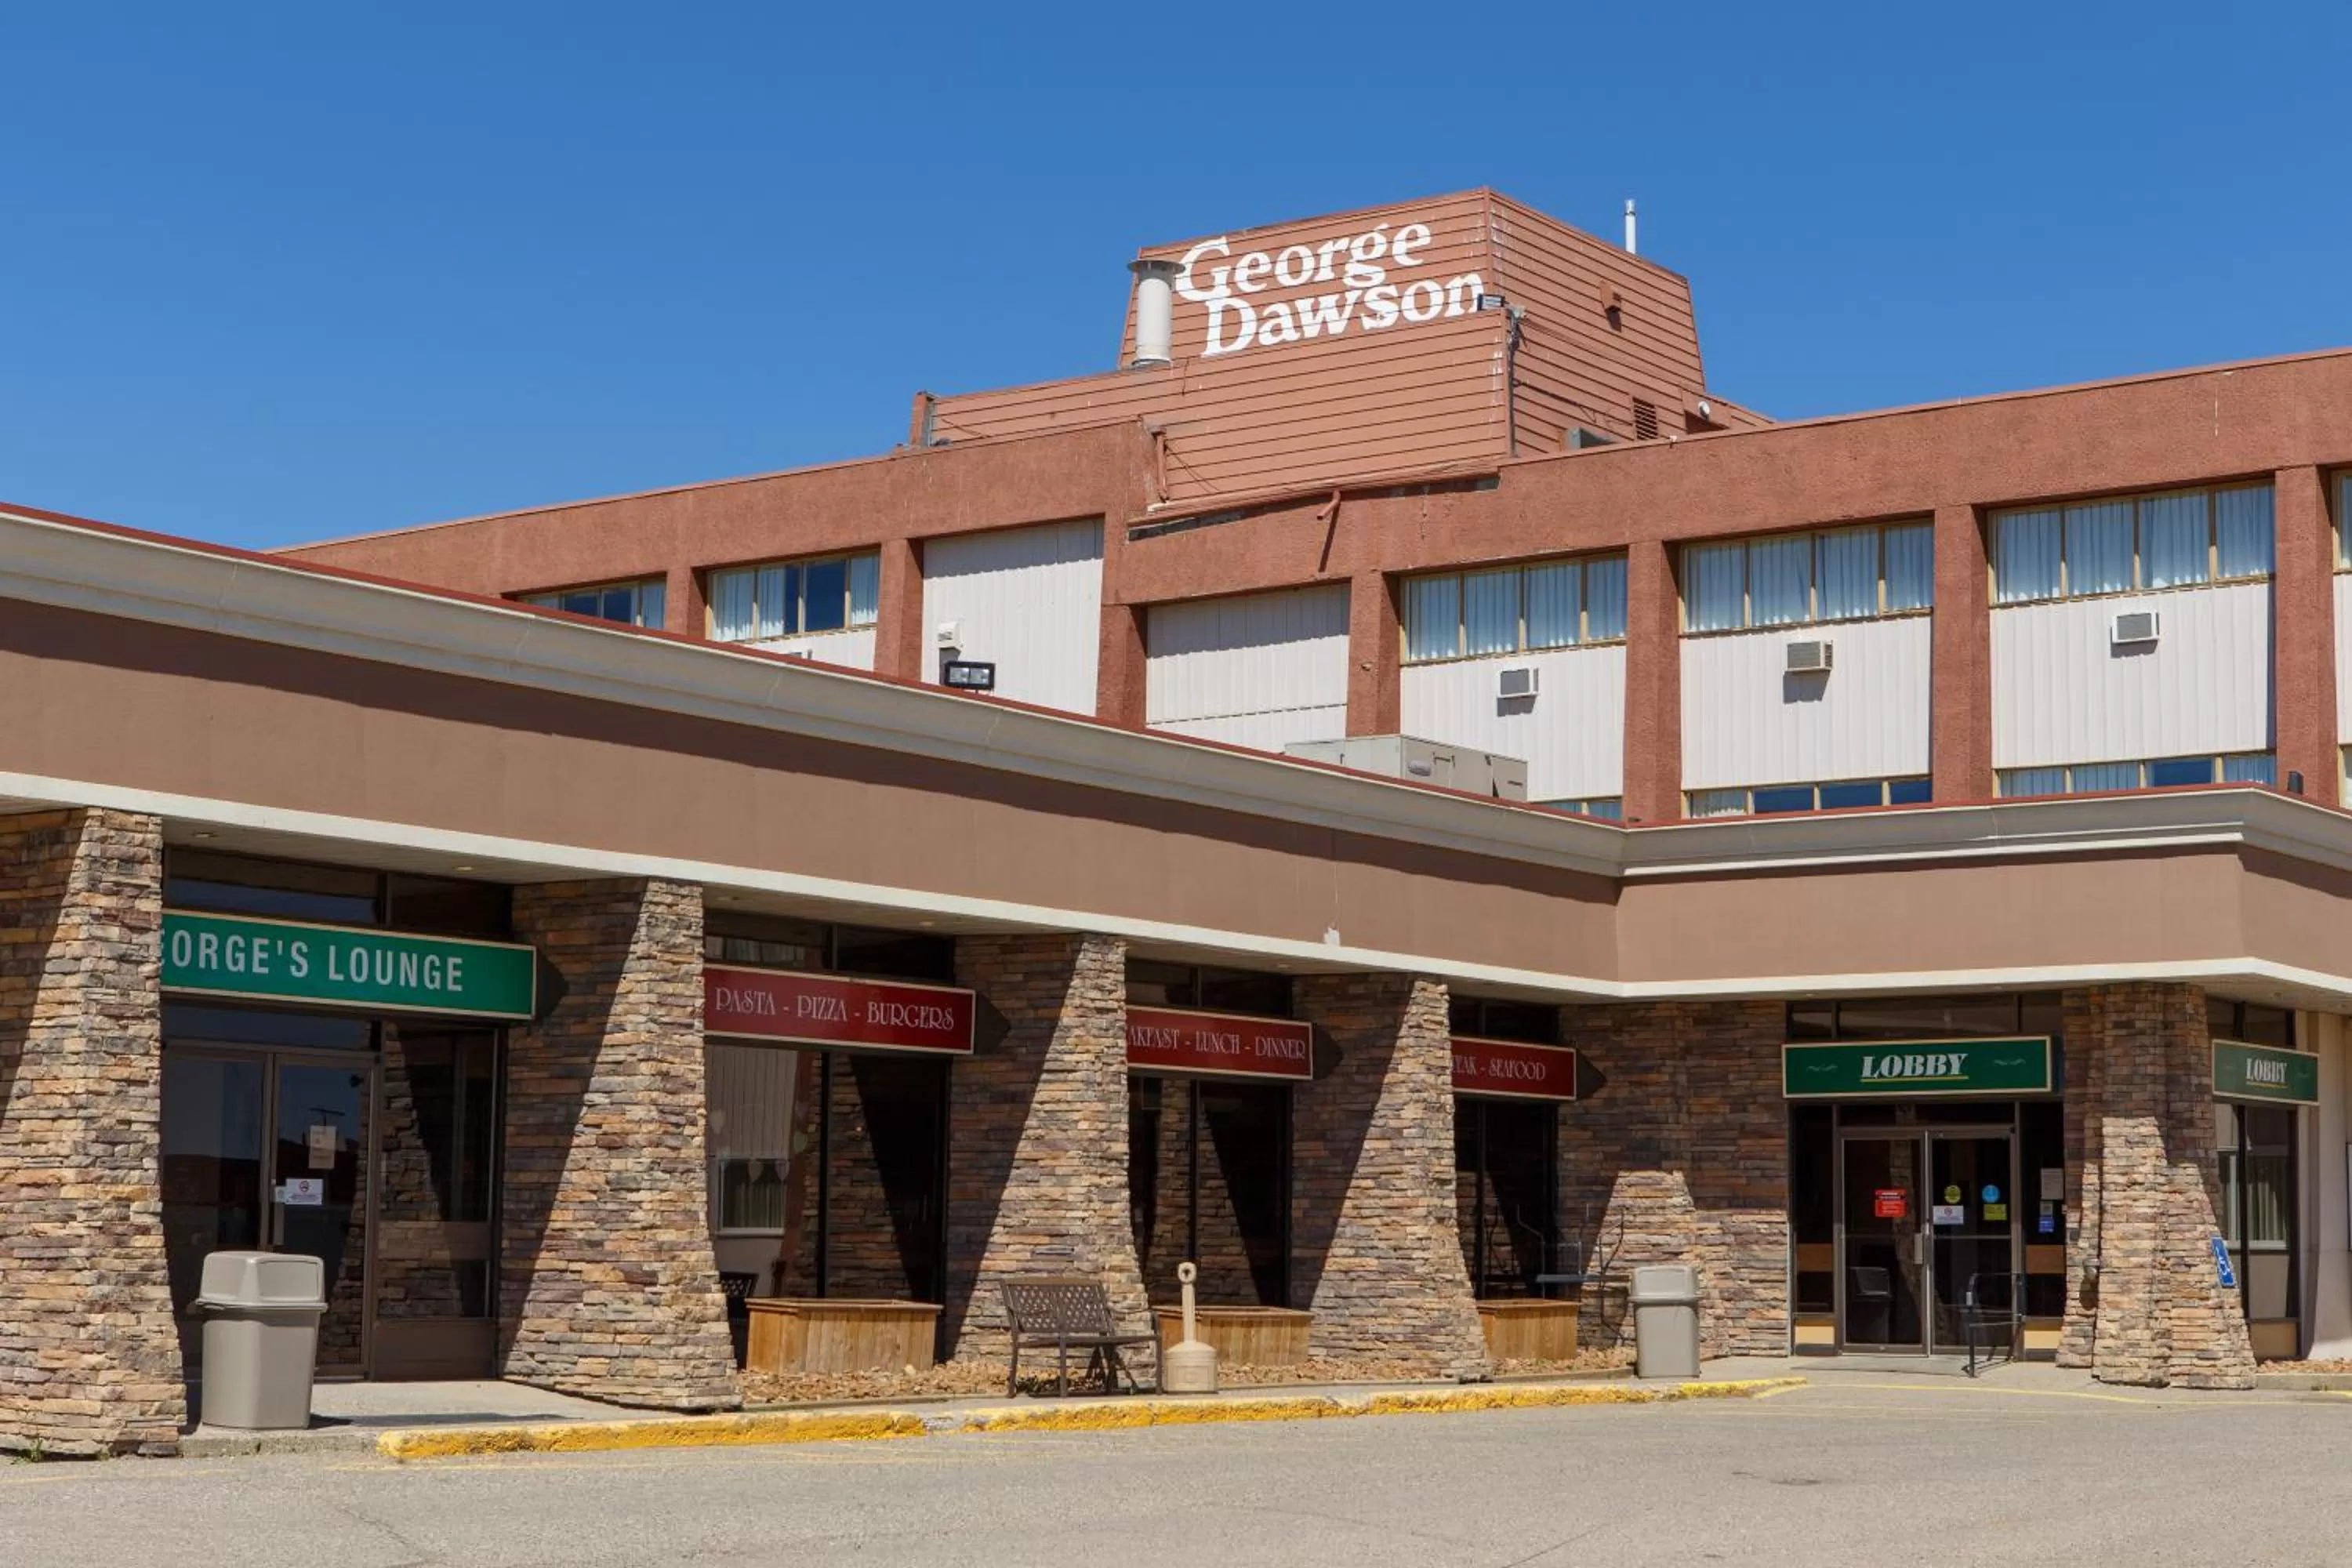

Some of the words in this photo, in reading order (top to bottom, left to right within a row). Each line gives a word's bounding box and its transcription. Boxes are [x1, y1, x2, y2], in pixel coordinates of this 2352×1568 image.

[1175, 223, 1432, 303] George
[1200, 273, 1485, 358] Dawson
[162, 928, 309, 978] ORGE'S
[328, 944, 464, 993] LOUNGE
[715, 986, 776, 1016] PASTA
[797, 995, 848, 1022] PIZZA
[867, 1000, 954, 1031] BURGERS
[1195, 1031, 1240, 1054] LUNCH
[1255, 1036, 1305, 1059] DINNER
[1489, 1058, 1546, 1081] SEAFOOD
[1860, 1053, 1969, 1079] LOBBY
[2245, 1058, 2288, 1083] LOBBY
